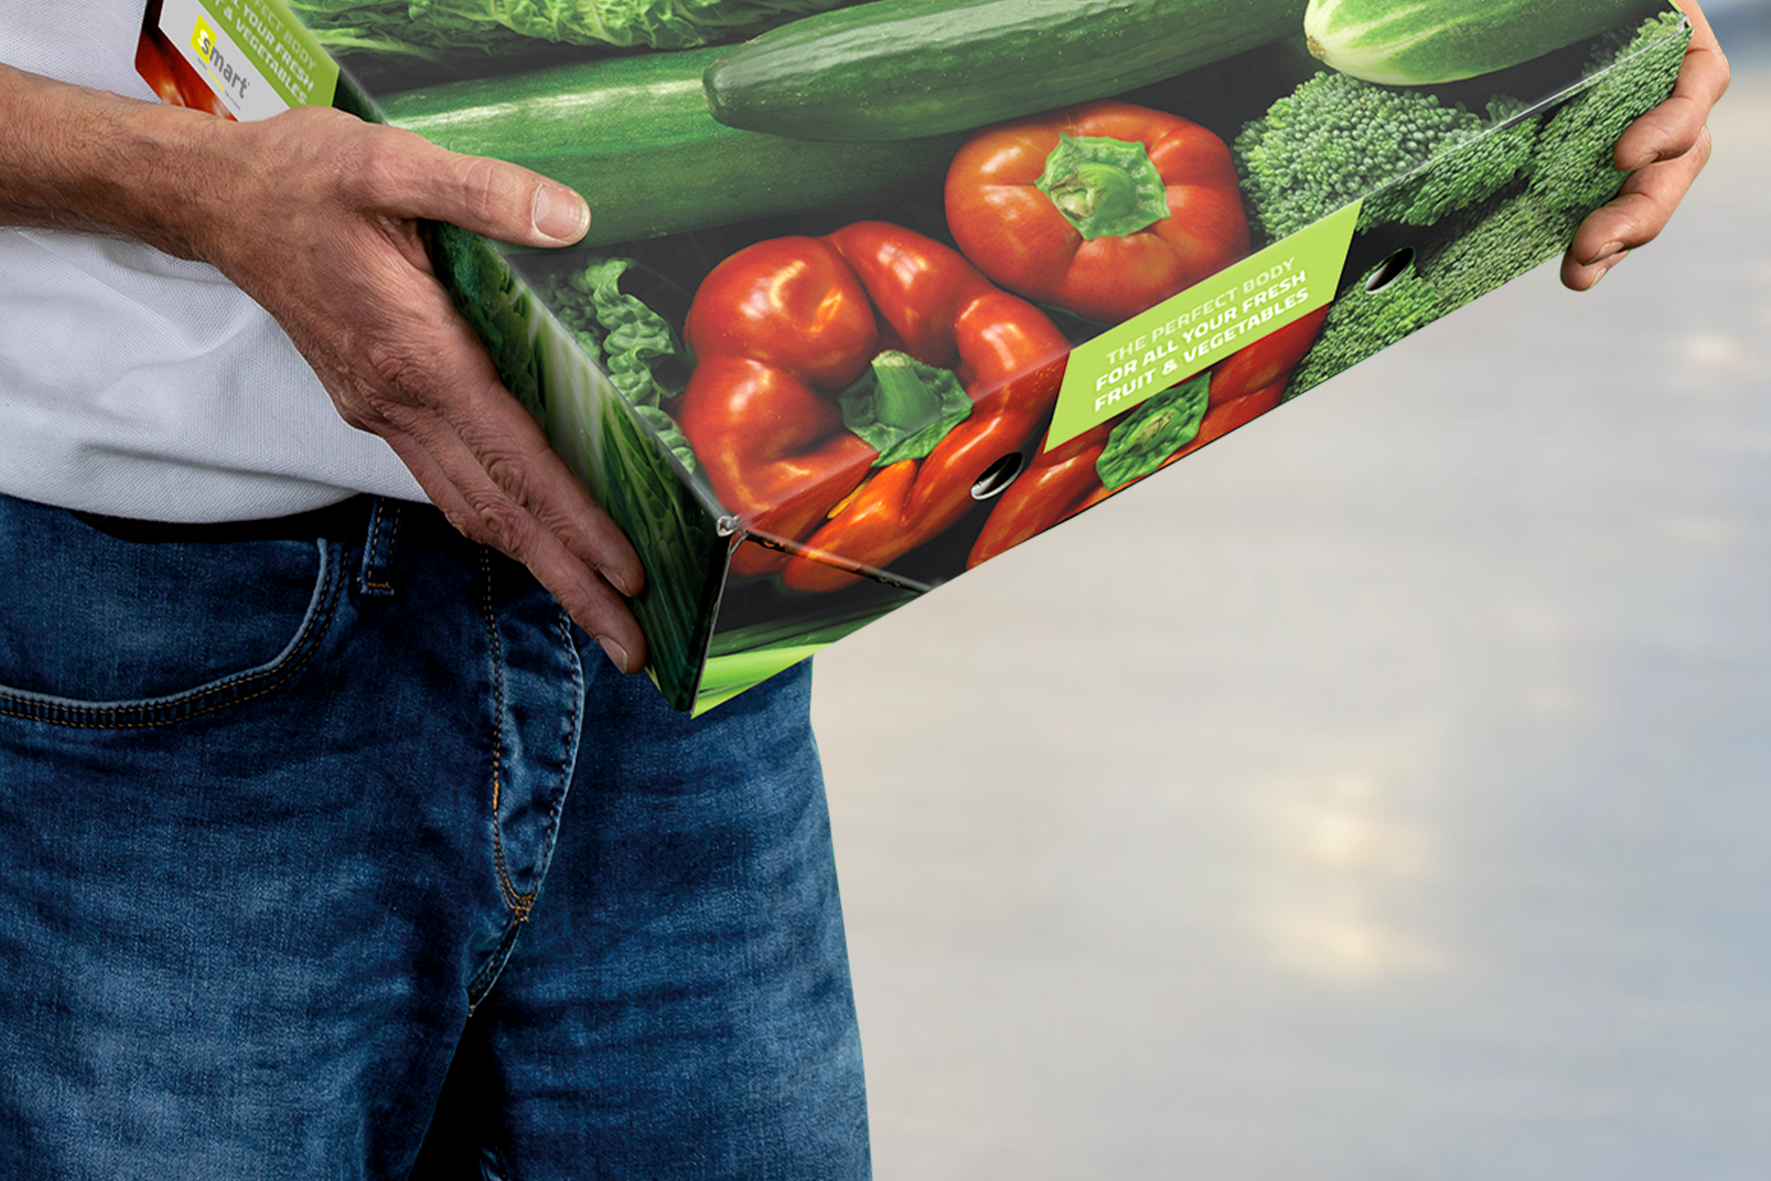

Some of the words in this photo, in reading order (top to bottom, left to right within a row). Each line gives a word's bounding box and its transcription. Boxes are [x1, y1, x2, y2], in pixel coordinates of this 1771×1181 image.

[224, 7, 233, 22] &
[236, 19, 307, 105] VEGETABLES
[244, 4, 275, 46] YOUR
[275, 42, 314, 92] FRESH
[283, 30, 317, 70] BODY
[1094, 374, 1154, 412] FRUIT
[1161, 360, 1179, 375] &
[1183, 288, 1309, 362] VEGETABLES
[1095, 362, 1138, 392] FOR
[1142, 342, 1178, 368] ALL
[1182, 309, 1238, 344] YOUR
[1242, 270, 1307, 313] FRESH
[1105, 334, 1147, 365] THE
[1152, 288, 1239, 340] PERFECT
[1243, 257, 1295, 293] BODY
